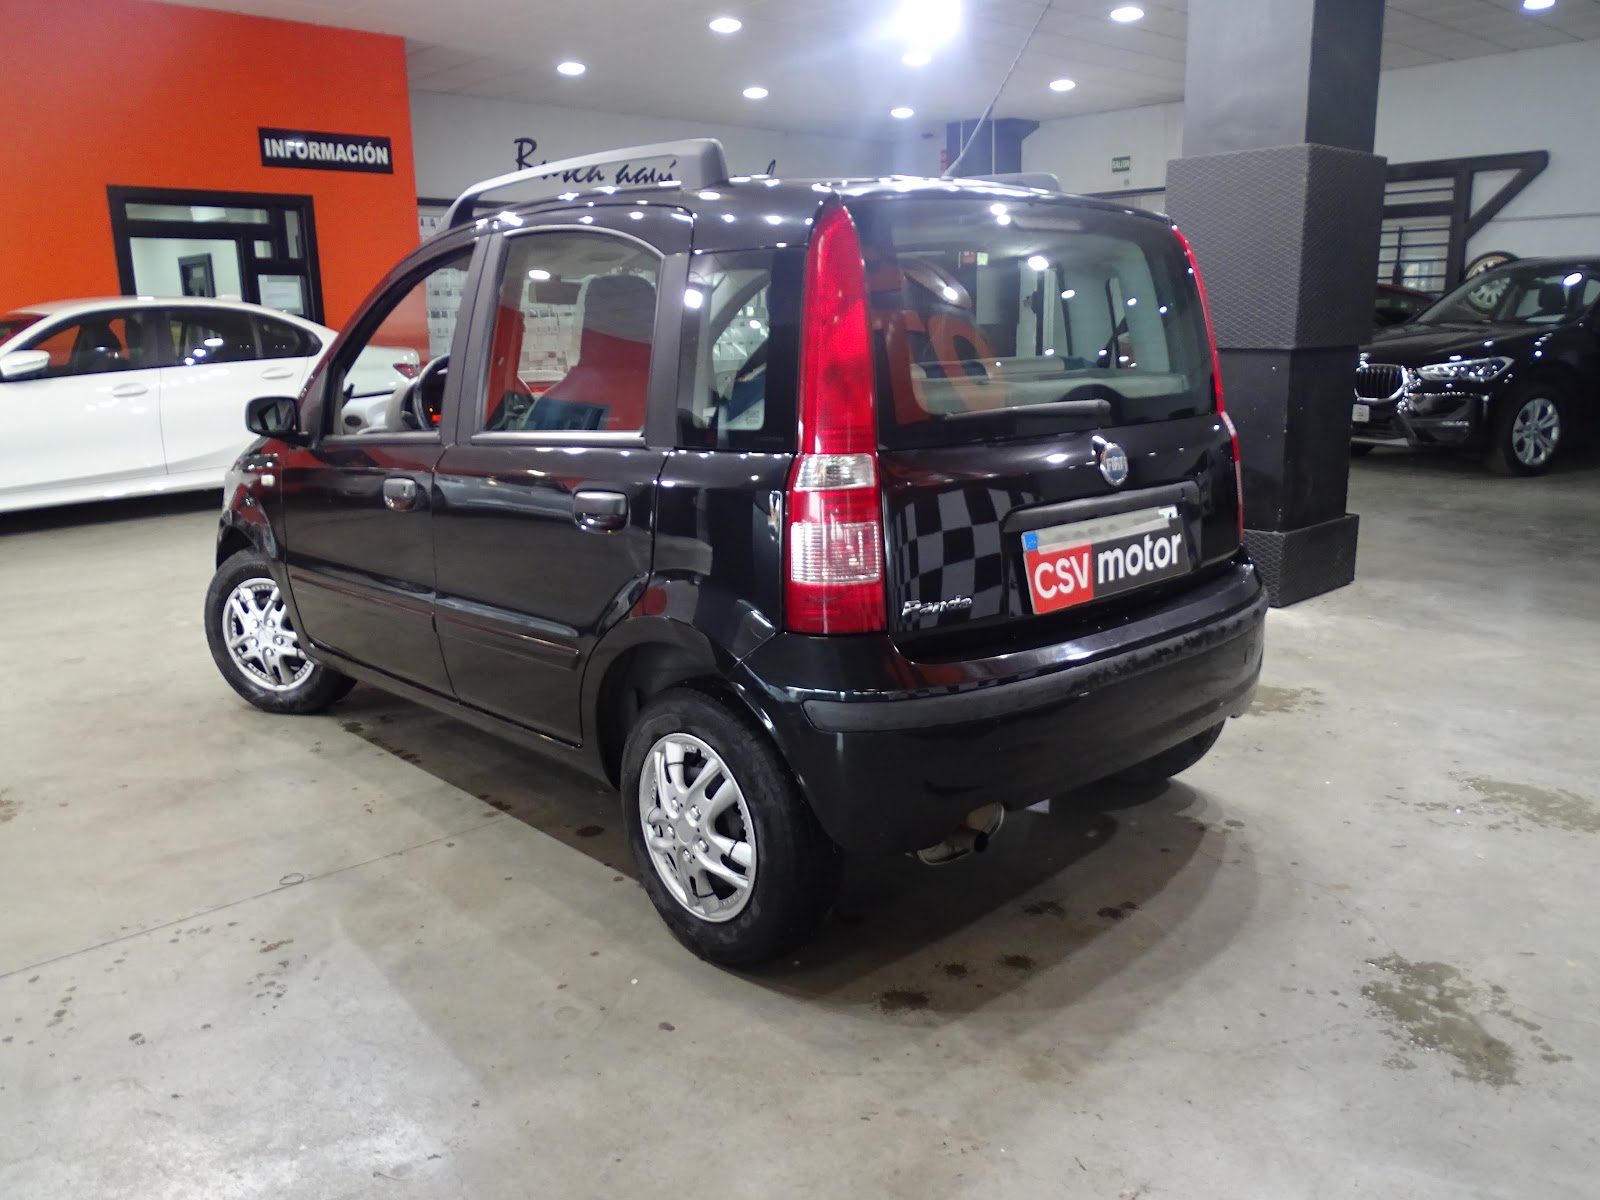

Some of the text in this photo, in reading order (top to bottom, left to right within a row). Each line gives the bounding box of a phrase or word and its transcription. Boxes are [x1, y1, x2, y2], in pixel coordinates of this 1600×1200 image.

[263, 137, 390, 165] INFORMACIÓN
[1034, 533, 1182, 599] CSV motor
[901, 594, 973, 616] Panda
